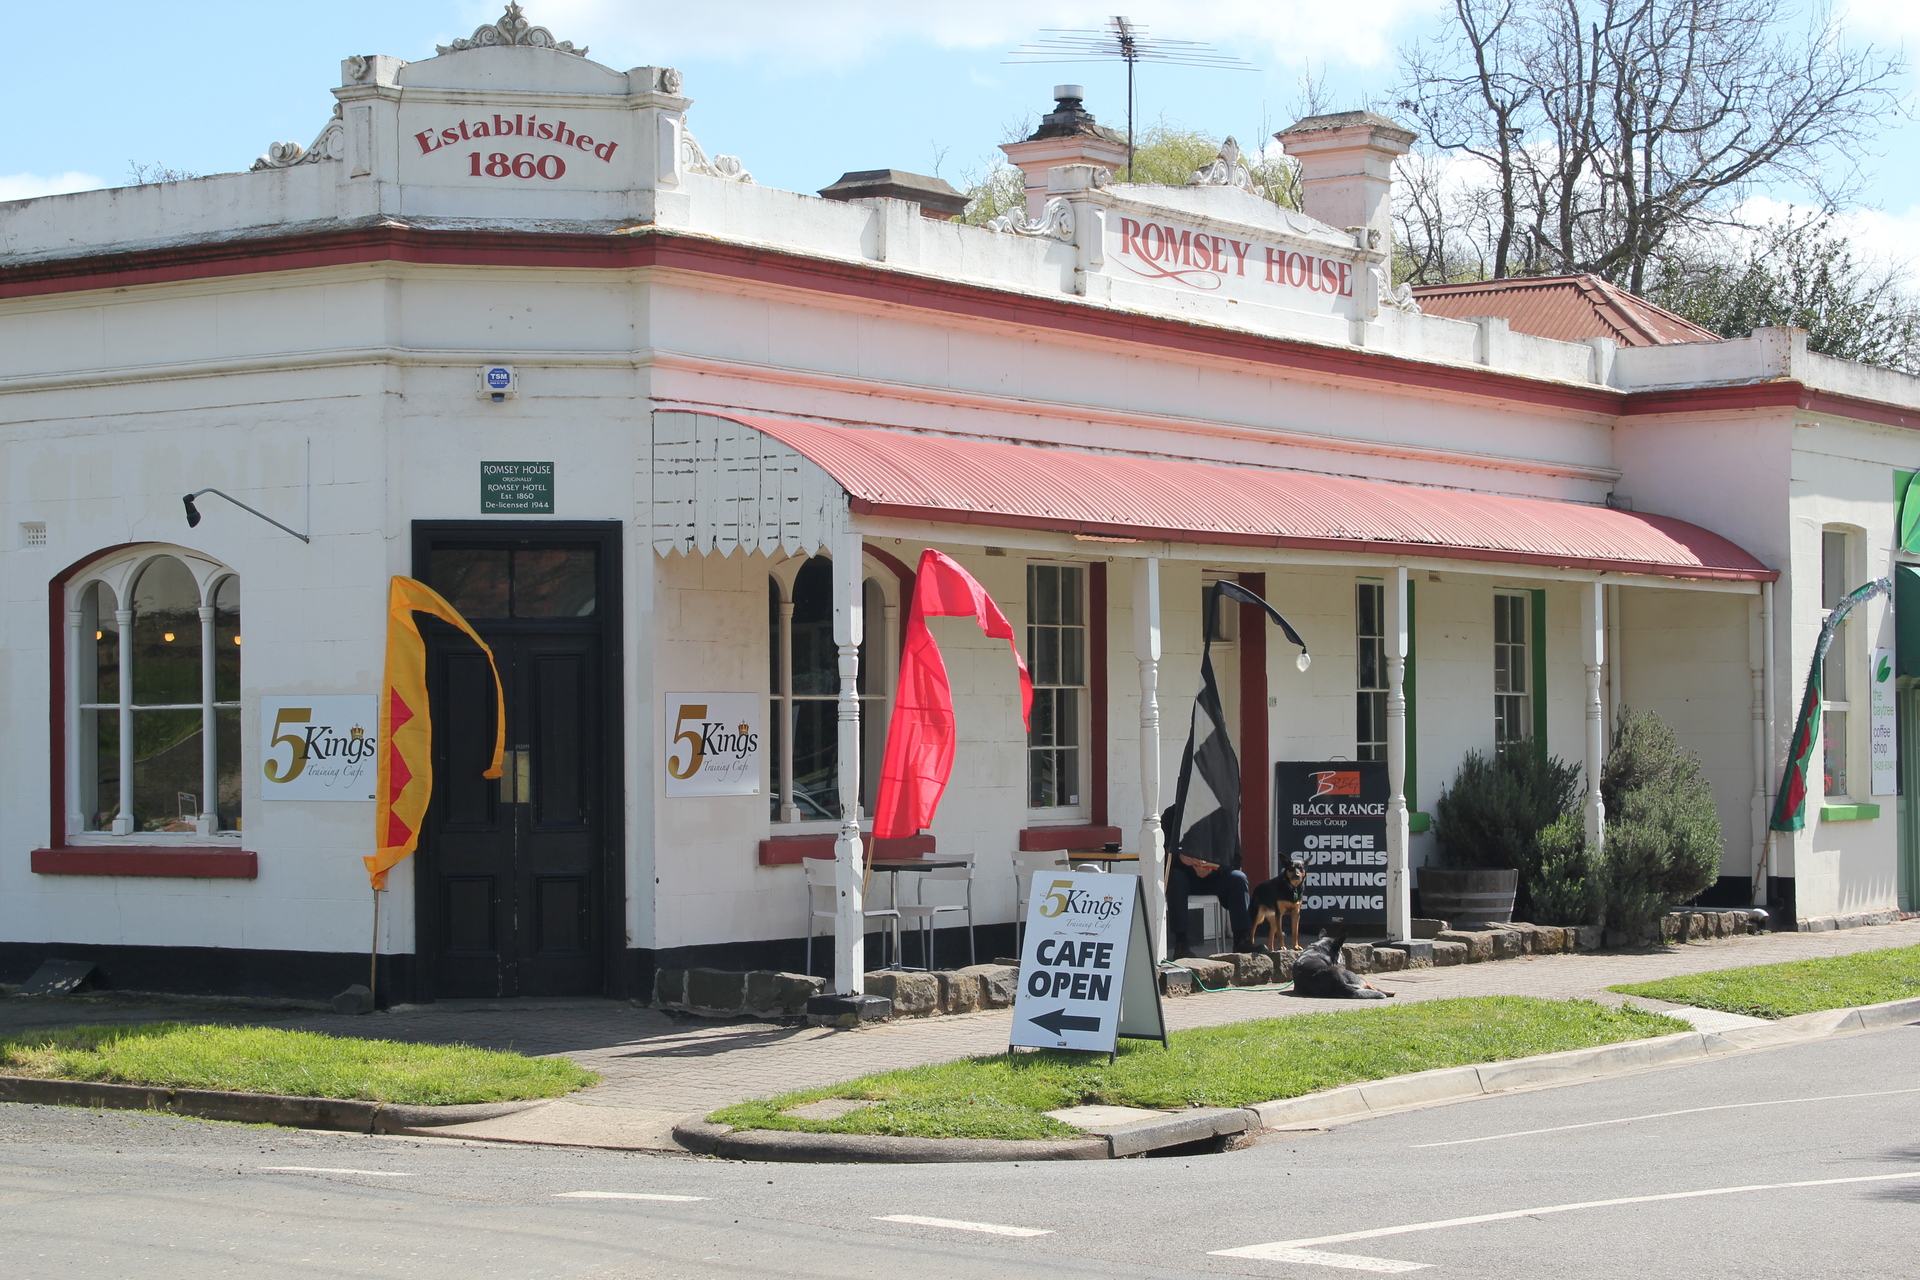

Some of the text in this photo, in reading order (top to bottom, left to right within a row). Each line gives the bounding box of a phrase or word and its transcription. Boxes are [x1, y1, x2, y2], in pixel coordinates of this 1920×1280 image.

[414, 114, 619, 163] Established
[468, 152, 567, 180] 1860
[1107, 218, 1353, 297] ROMSEY HOUSE
[484, 465, 551, 475] ROMSEY HOUSE
[487, 484, 520, 492] ROMSEY
[500, 492, 535, 500] Est. 1860
[1873, 689, 1882, 701] the
[1873, 704, 1894, 719] baytree
[1873, 725, 1891, 738] coffee
[1873, 741, 1888, 756] shop
[307, 763, 340, 787] Training
[704, 760, 730, 782] Training
[1292, 803, 1385, 815] BLACK RANGE
[1292, 818, 1348, 828] Business Group
[1303, 835, 1375, 849] OFFICE
[1304, 872, 1387, 887] RINTING
[1066, 918, 1093, 932] Training
[1036, 939, 1113, 969] CAFE
[1028, 970, 1112, 1001] OPEN
